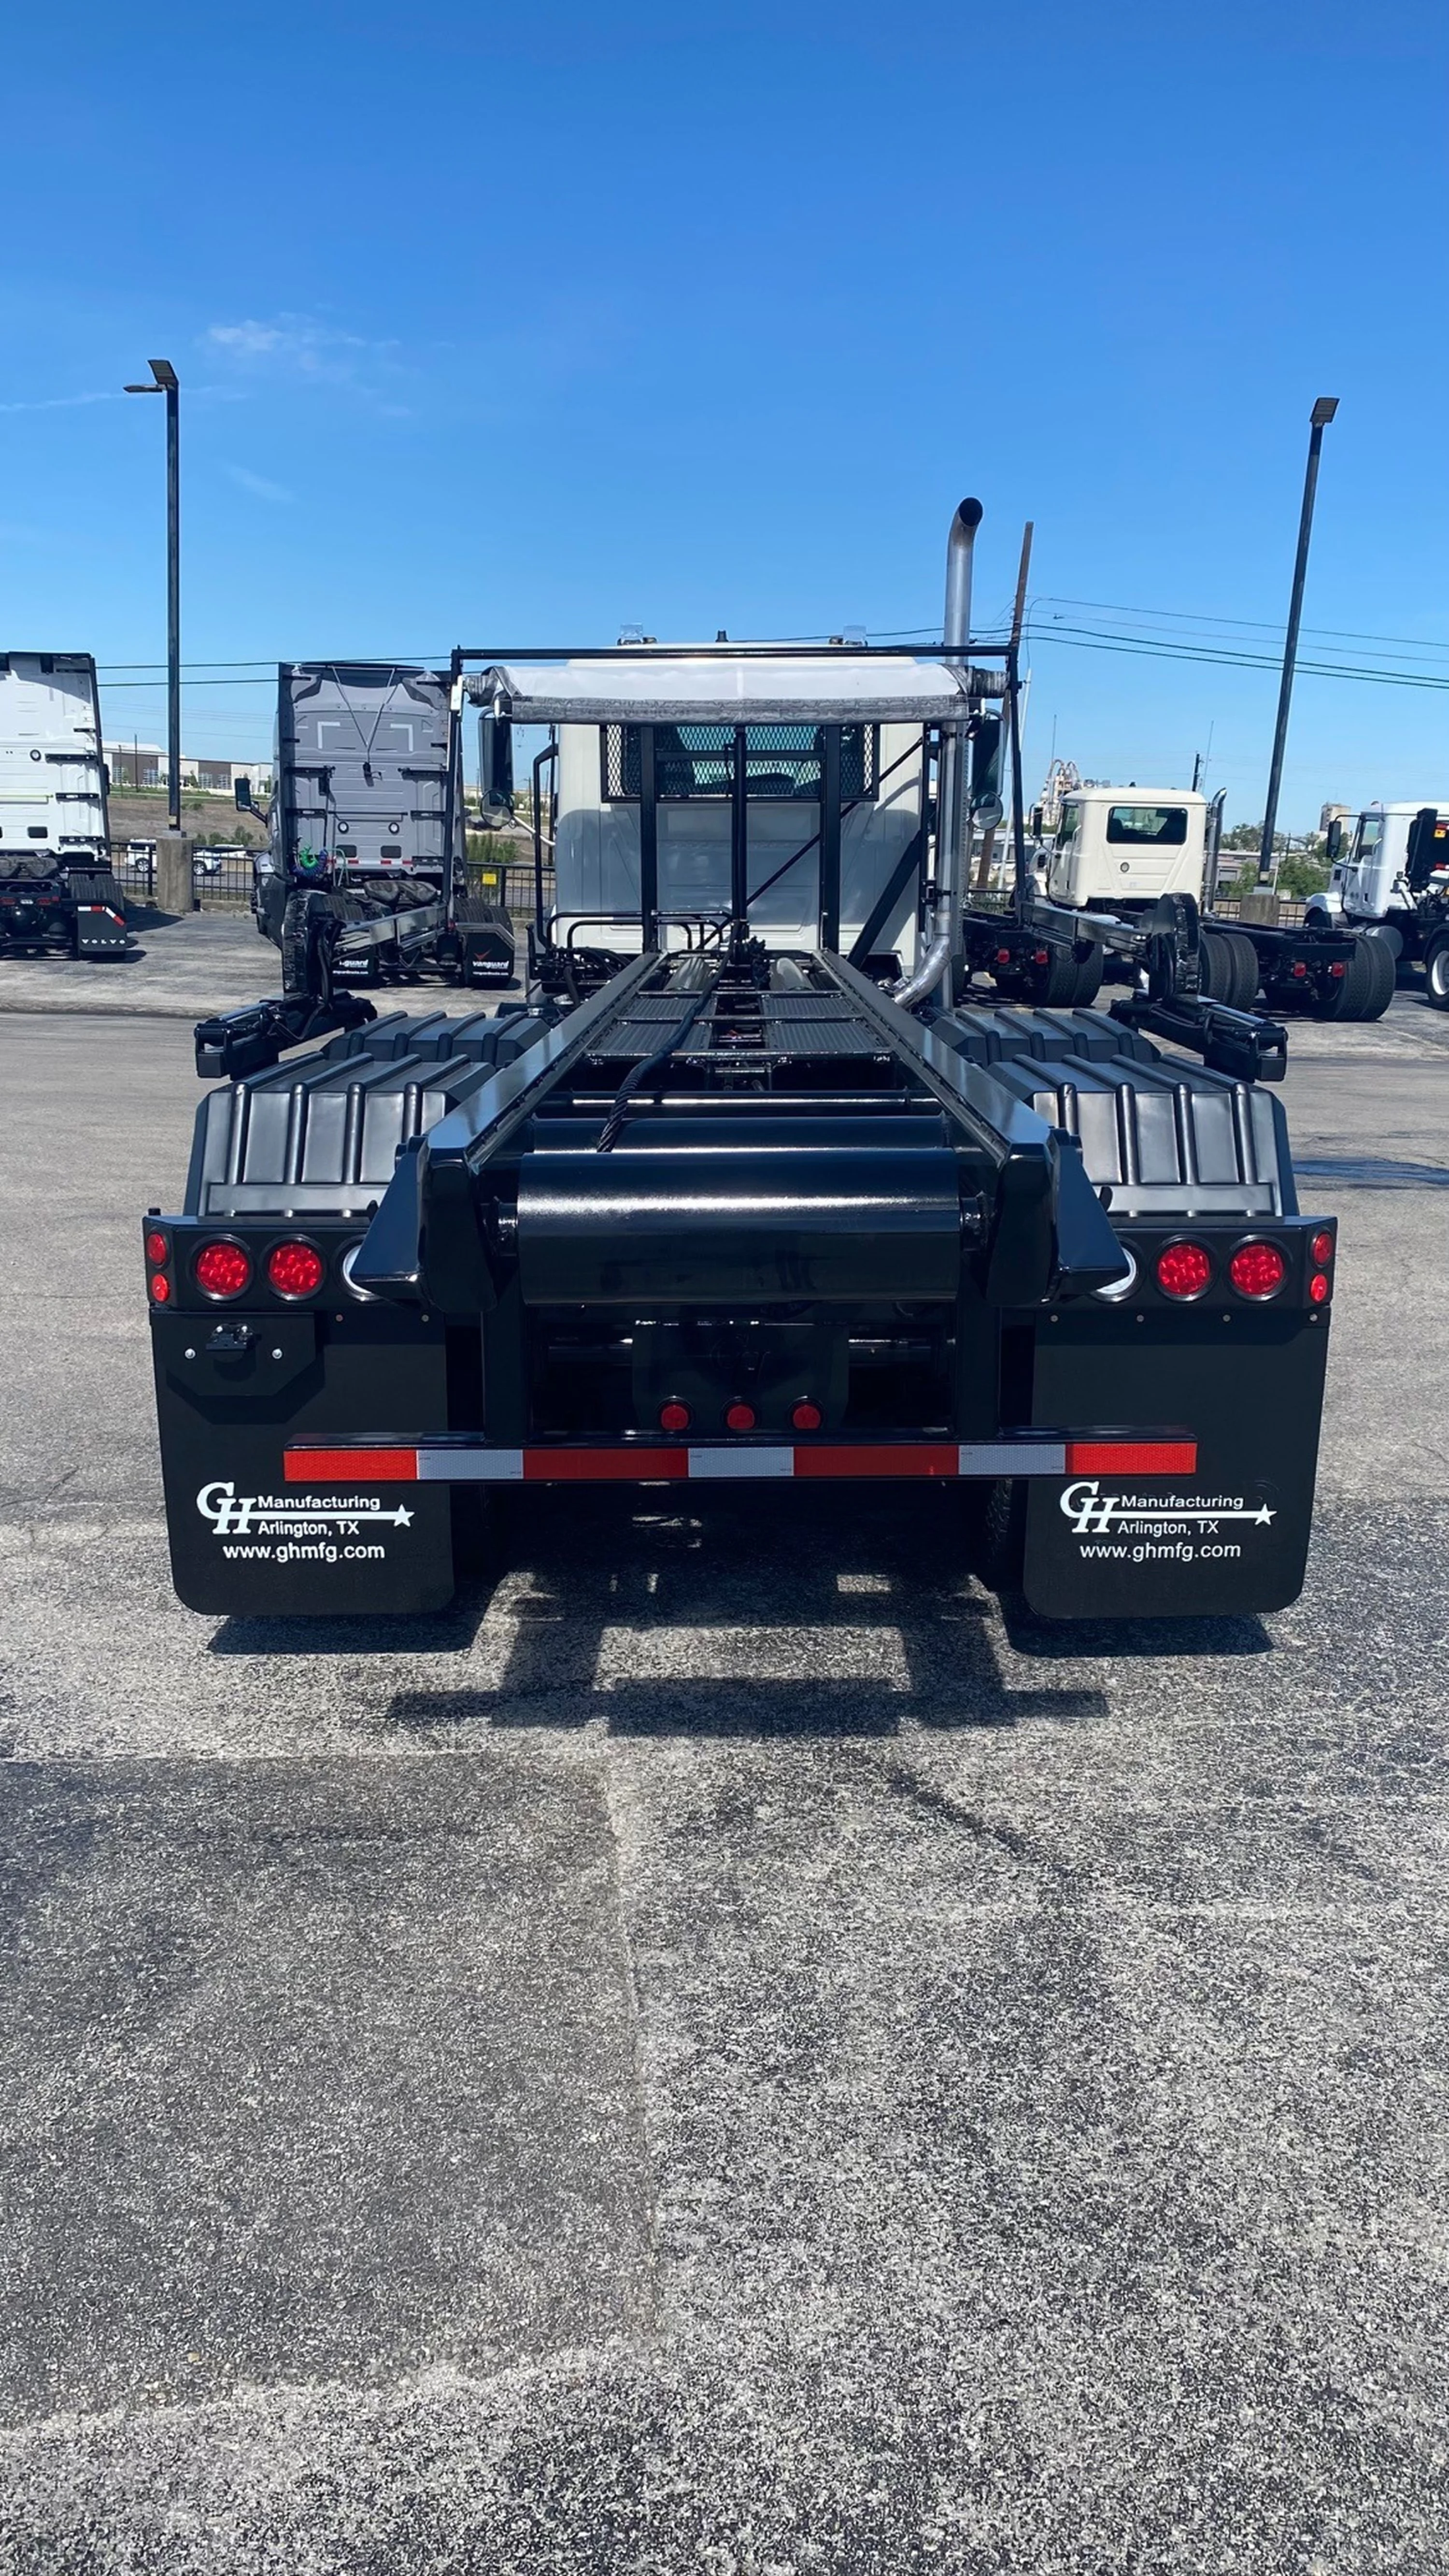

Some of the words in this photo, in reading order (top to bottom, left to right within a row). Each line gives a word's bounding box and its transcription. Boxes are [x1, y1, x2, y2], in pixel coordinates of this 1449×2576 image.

[472, 960, 509, 969] vanguard
[258, 1495, 381, 1510] Manufacturing
[1121, 1494, 1244, 1510] Manufacturing
[258, 1521, 332, 1538] Arlington,
[336, 1521, 359, 1535] TX
[1117, 1520, 1192, 1537] Arlington,
[1197, 1520, 1219, 1534] TX
[222, 1542, 385, 1563] www.ghmfg.com
[1080, 1542, 1241, 1563] www.ghmfg.com
